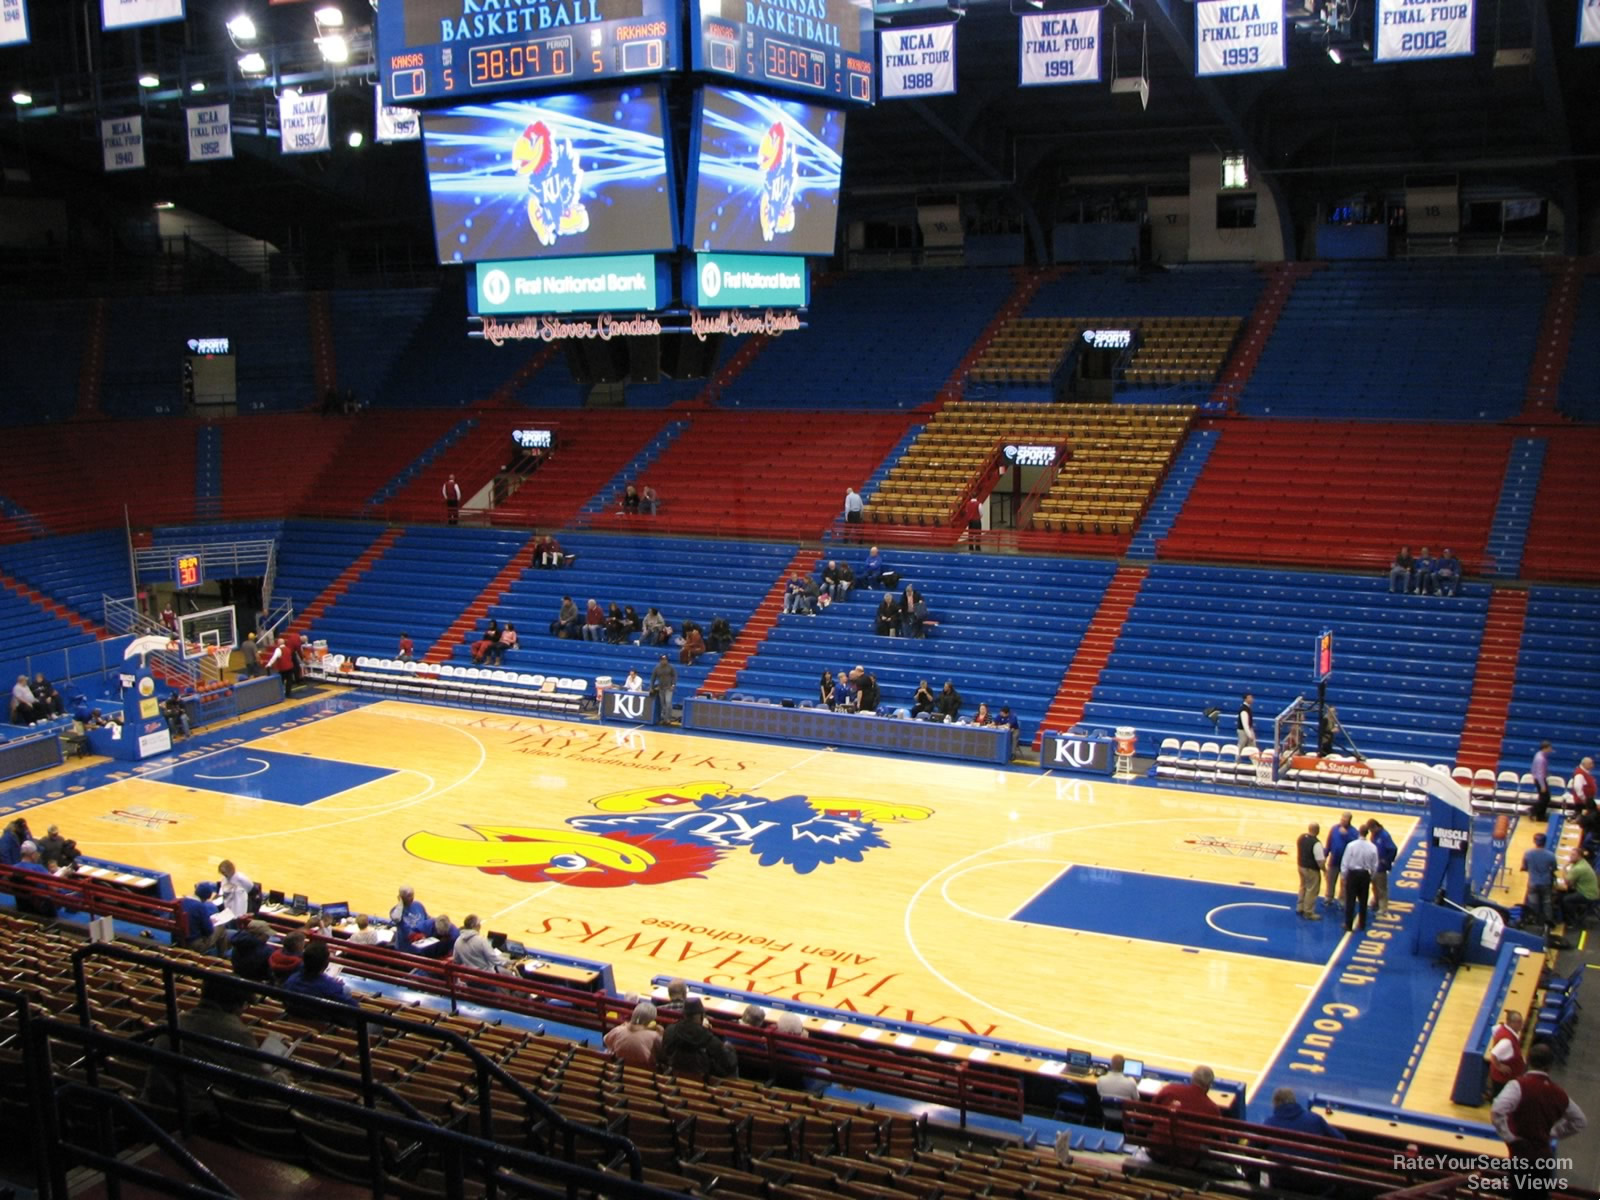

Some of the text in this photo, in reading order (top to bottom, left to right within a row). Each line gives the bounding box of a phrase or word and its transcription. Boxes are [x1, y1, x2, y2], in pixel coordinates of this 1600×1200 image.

[441, 0, 602, 42] BASKETBALL
[1219, 5, 1260, 23] NCAA
[1383, 5, 1468, 25] FINAL FOUR
[616, 21, 666, 41] ARKANSAS
[746, 2, 840, 47] BASKETBALL
[1041, 18, 1079, 36] NCAA
[1202, 23, 1278, 41] FINAL FOUR
[546, 38, 570, 50] PERIOD
[899, 33, 935, 50] NCAA
[1026, 36, 1095, 54] FINAL FOUR
[1401, 31, 1447, 50] 2002
[391, 53, 424, 70] KANSAS
[476, 45, 540, 81] 38:09
[552, 49, 565, 74] 0
[592, 50, 603, 73] 5
[647, 42, 660, 68] 0
[886, 50, 950, 67] FINAL FOUR
[1222, 47, 1259, 66] 1993
[1044, 60, 1074, 77] 1991
[412, 70, 424, 95] 0
[443, 69, 454, 90] 5
[902, 72, 933, 89] 1988
[197, 110, 219, 124] NCAA
[292, 102, 315, 115] NCAA
[111, 122, 132, 135] NCAA
[283, 117, 305, 129] FINAL
[393, 121, 415, 134] 1957
[200, 142, 220, 155] 1952
[294, 133, 316, 147] 1953
[115, 152, 134, 165] 1940
[541, 173, 561, 203] KU
[1425, 206, 1440, 217] 18
[515, 276, 542, 295] First
[543, 274, 606, 293] National
[607, 272, 647, 291] Bank
[723, 271, 741, 289] First
[741, 271, 779, 289] National
[779, 272, 801, 289] Bank
[480, 312, 662, 347] Russell Stover Candies
[690, 307, 730, 342] Russell
[730, 307, 765, 337] Stover
[1016, 450, 1056, 460] SPORTS
[181, 567, 196, 584] 30
[613, 693, 646, 719] KU
[260, 709, 338, 734] Court
[506, 734, 757, 771] JAYHAWKS
[512, 747, 672, 773] Allen Fieldhouse
[1054, 738, 1097, 768] KU
[1412, 775, 1430, 787] KU
[657, 803, 782, 843] KU
[1433, 827, 1468, 841] MUSCLE
[1438, 837, 1462, 850] MILK
[640, 917, 880, 966] Allen Fieldhouse
[1339, 900, 1416, 985] Naismith
[524, 916, 905, 998] JAYHAWKS
[1289, 1002, 1360, 1074] Court
